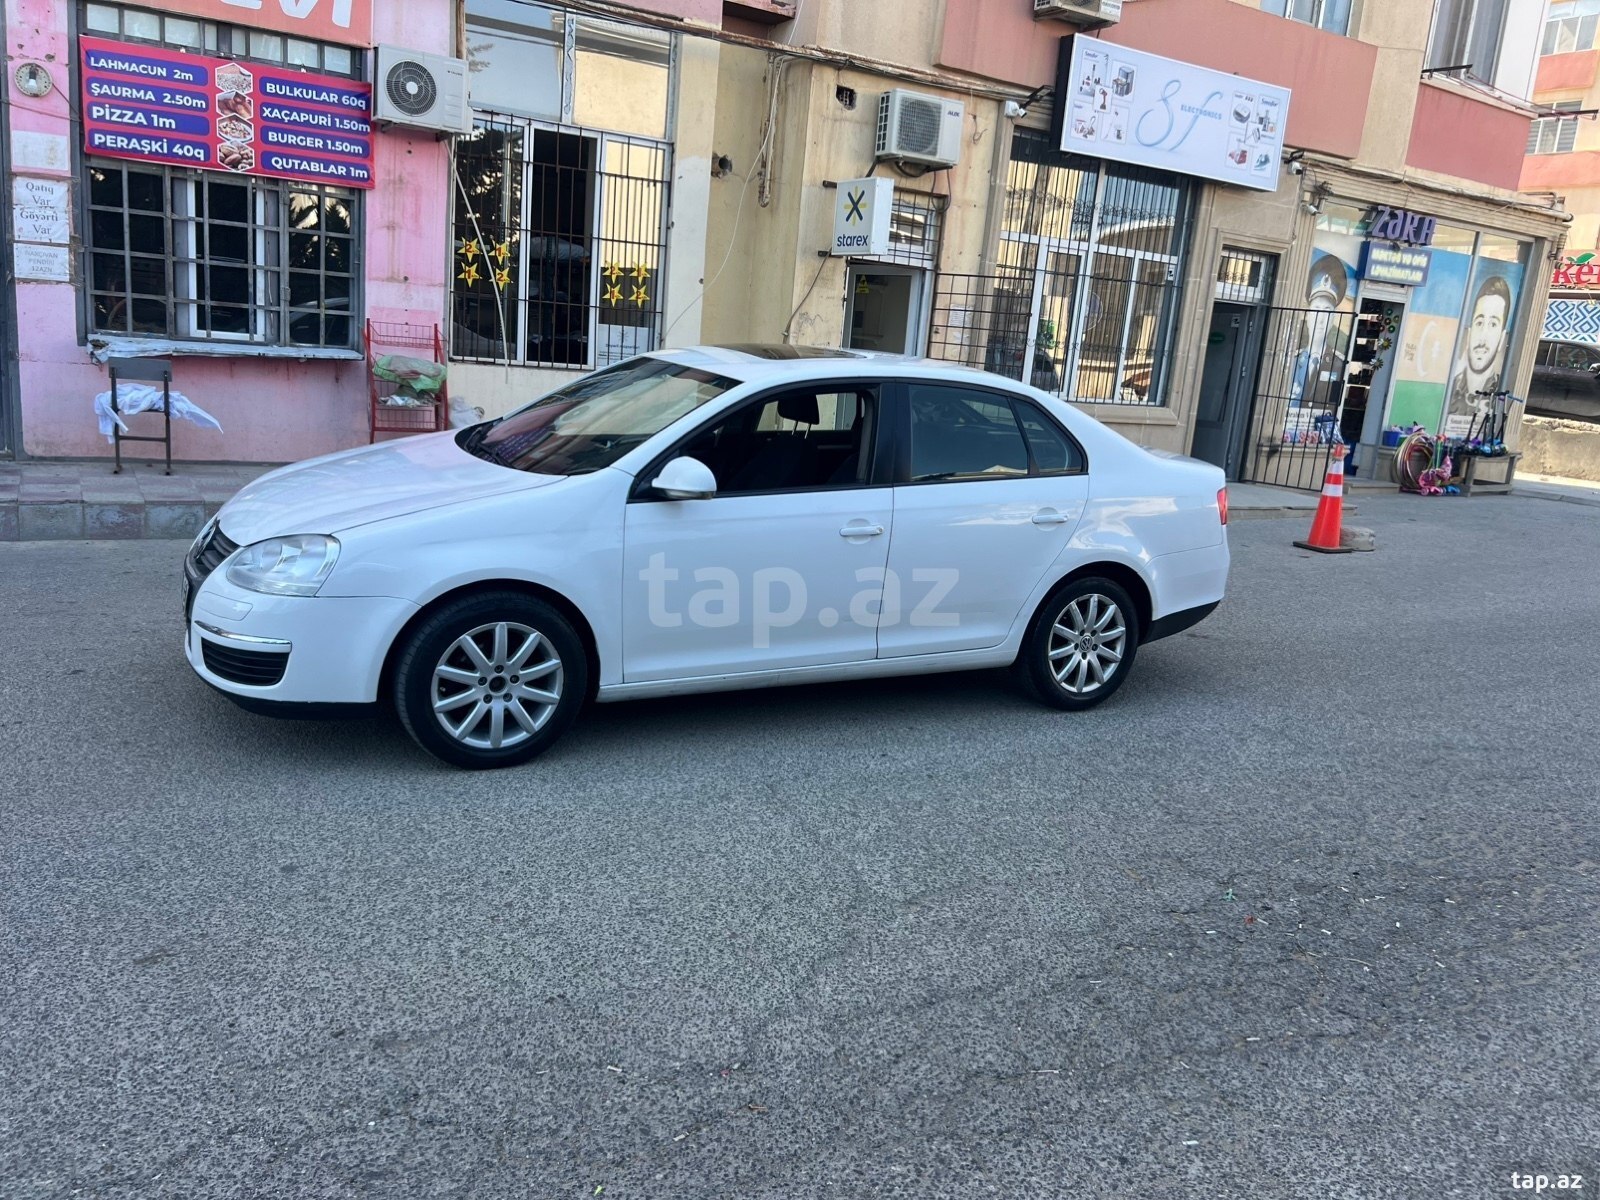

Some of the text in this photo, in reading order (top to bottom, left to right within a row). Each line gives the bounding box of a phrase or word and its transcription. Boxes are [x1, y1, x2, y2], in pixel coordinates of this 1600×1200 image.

[90, 56, 193, 81] LAHMACUN 2m
[91, 83, 206, 109] ŞAURMA 2.50m
[266, 82, 366, 110] BULKULAR 60q
[92, 104, 176, 129] PİZZA 1m
[262, 106, 371, 133] XAÇAPURİ 1.50m
[93, 133, 205, 161] PERAŞKİ 40q
[268, 131, 363, 155] BURGER 1.50m
[271, 156, 368, 179] QUTABLAR 1m
[25, 181, 54, 195] Qatıq
[32, 194, 52, 206] Var
[32, 224, 52, 235] Var
[837, 234, 869, 247] starex
